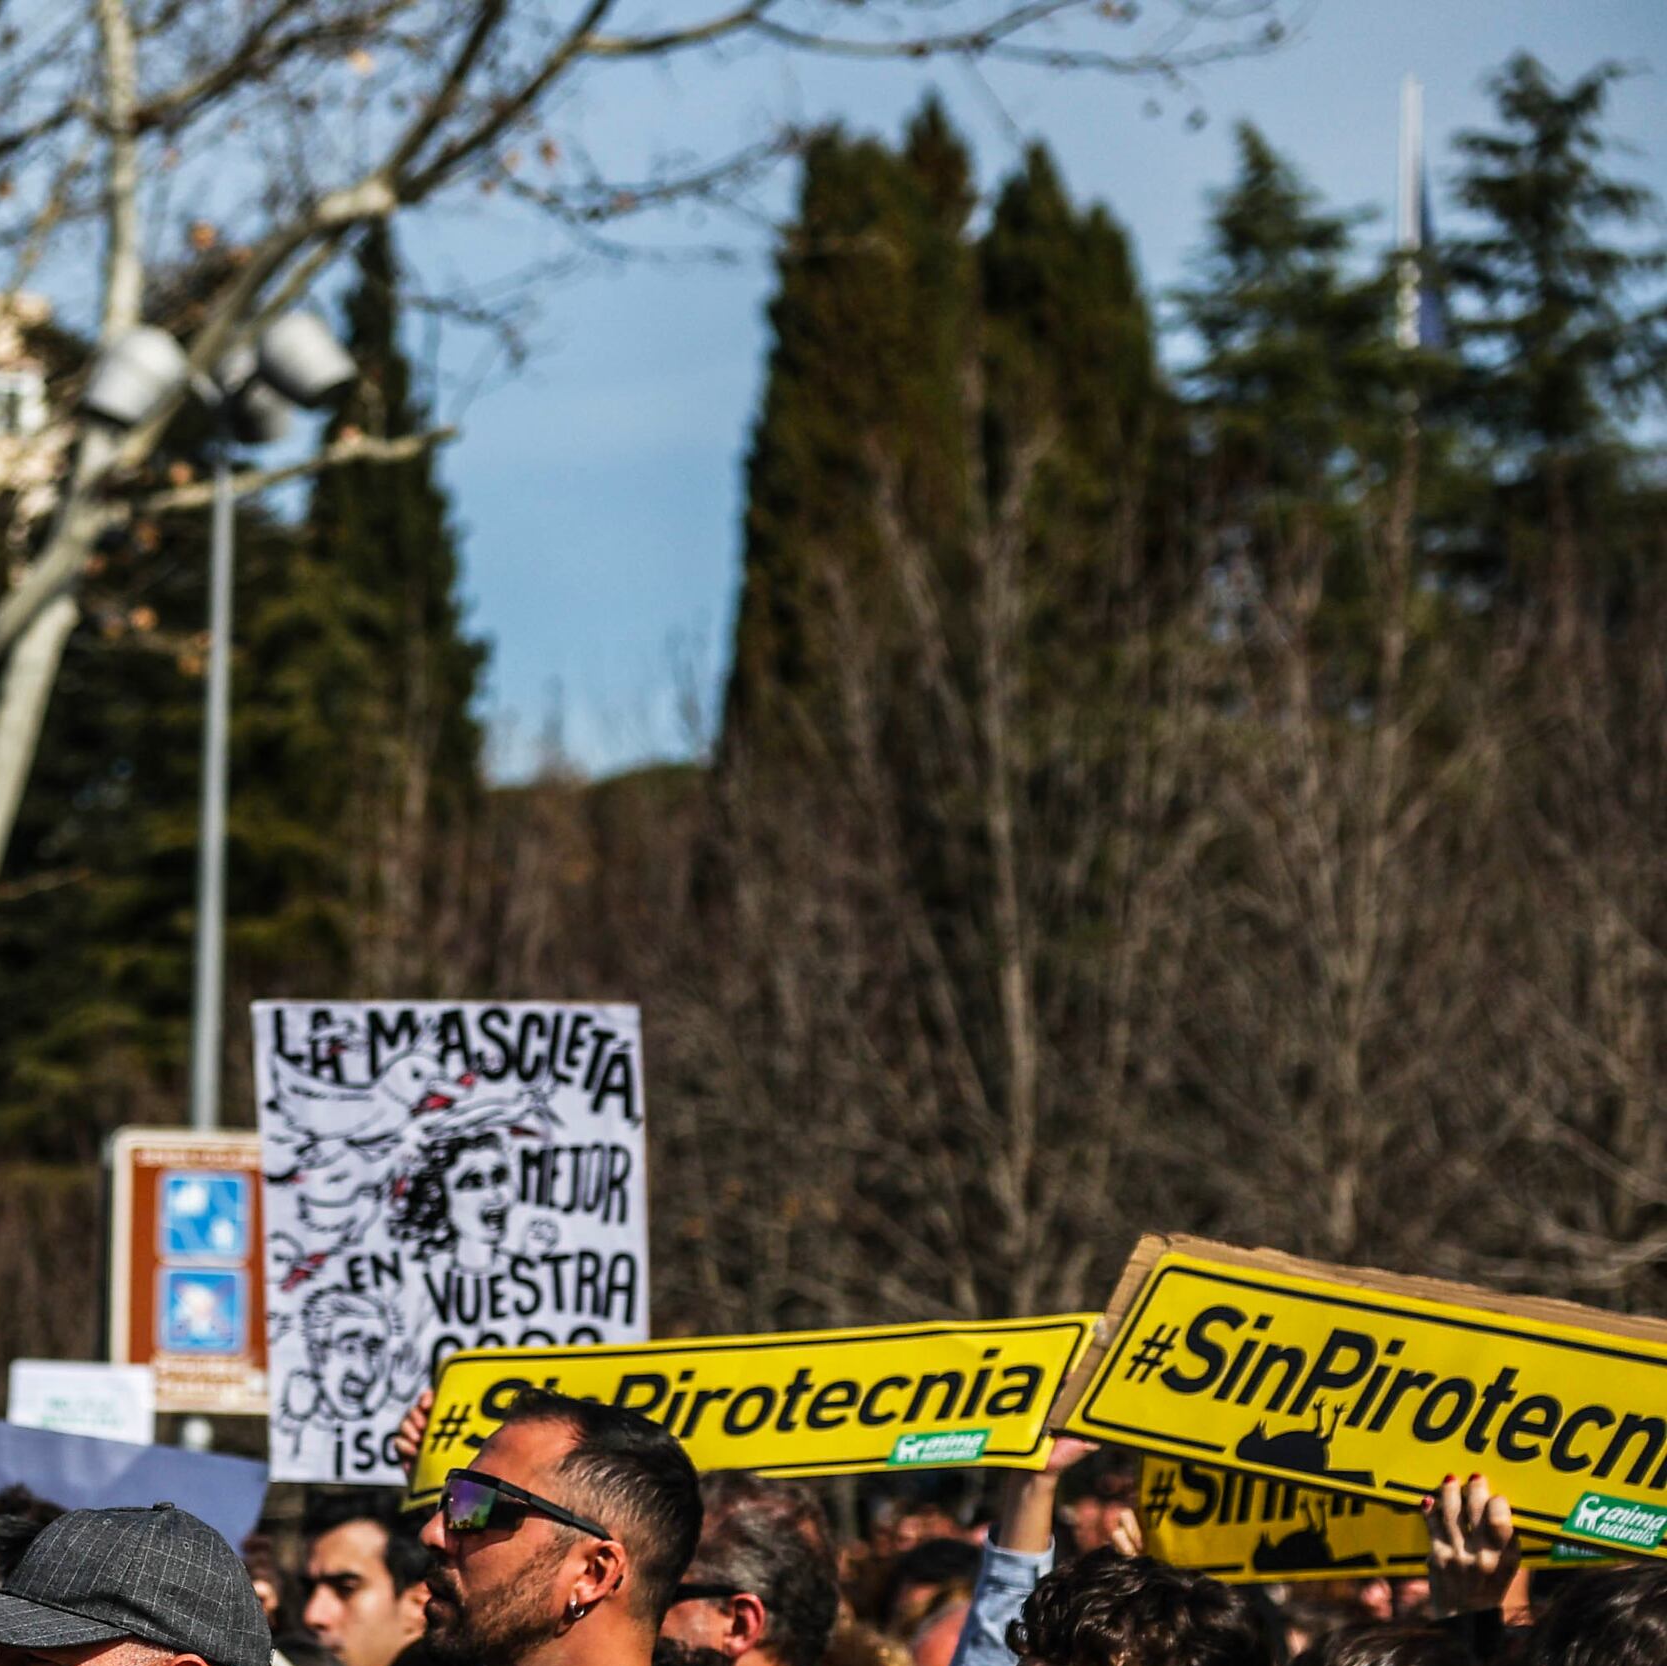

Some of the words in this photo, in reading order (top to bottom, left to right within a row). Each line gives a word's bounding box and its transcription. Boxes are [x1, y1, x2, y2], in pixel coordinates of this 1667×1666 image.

[518, 1142, 633, 1225] MEJOR
[346, 1250, 404, 1292] EN
[422, 1250, 639, 1328] VUESTRA
